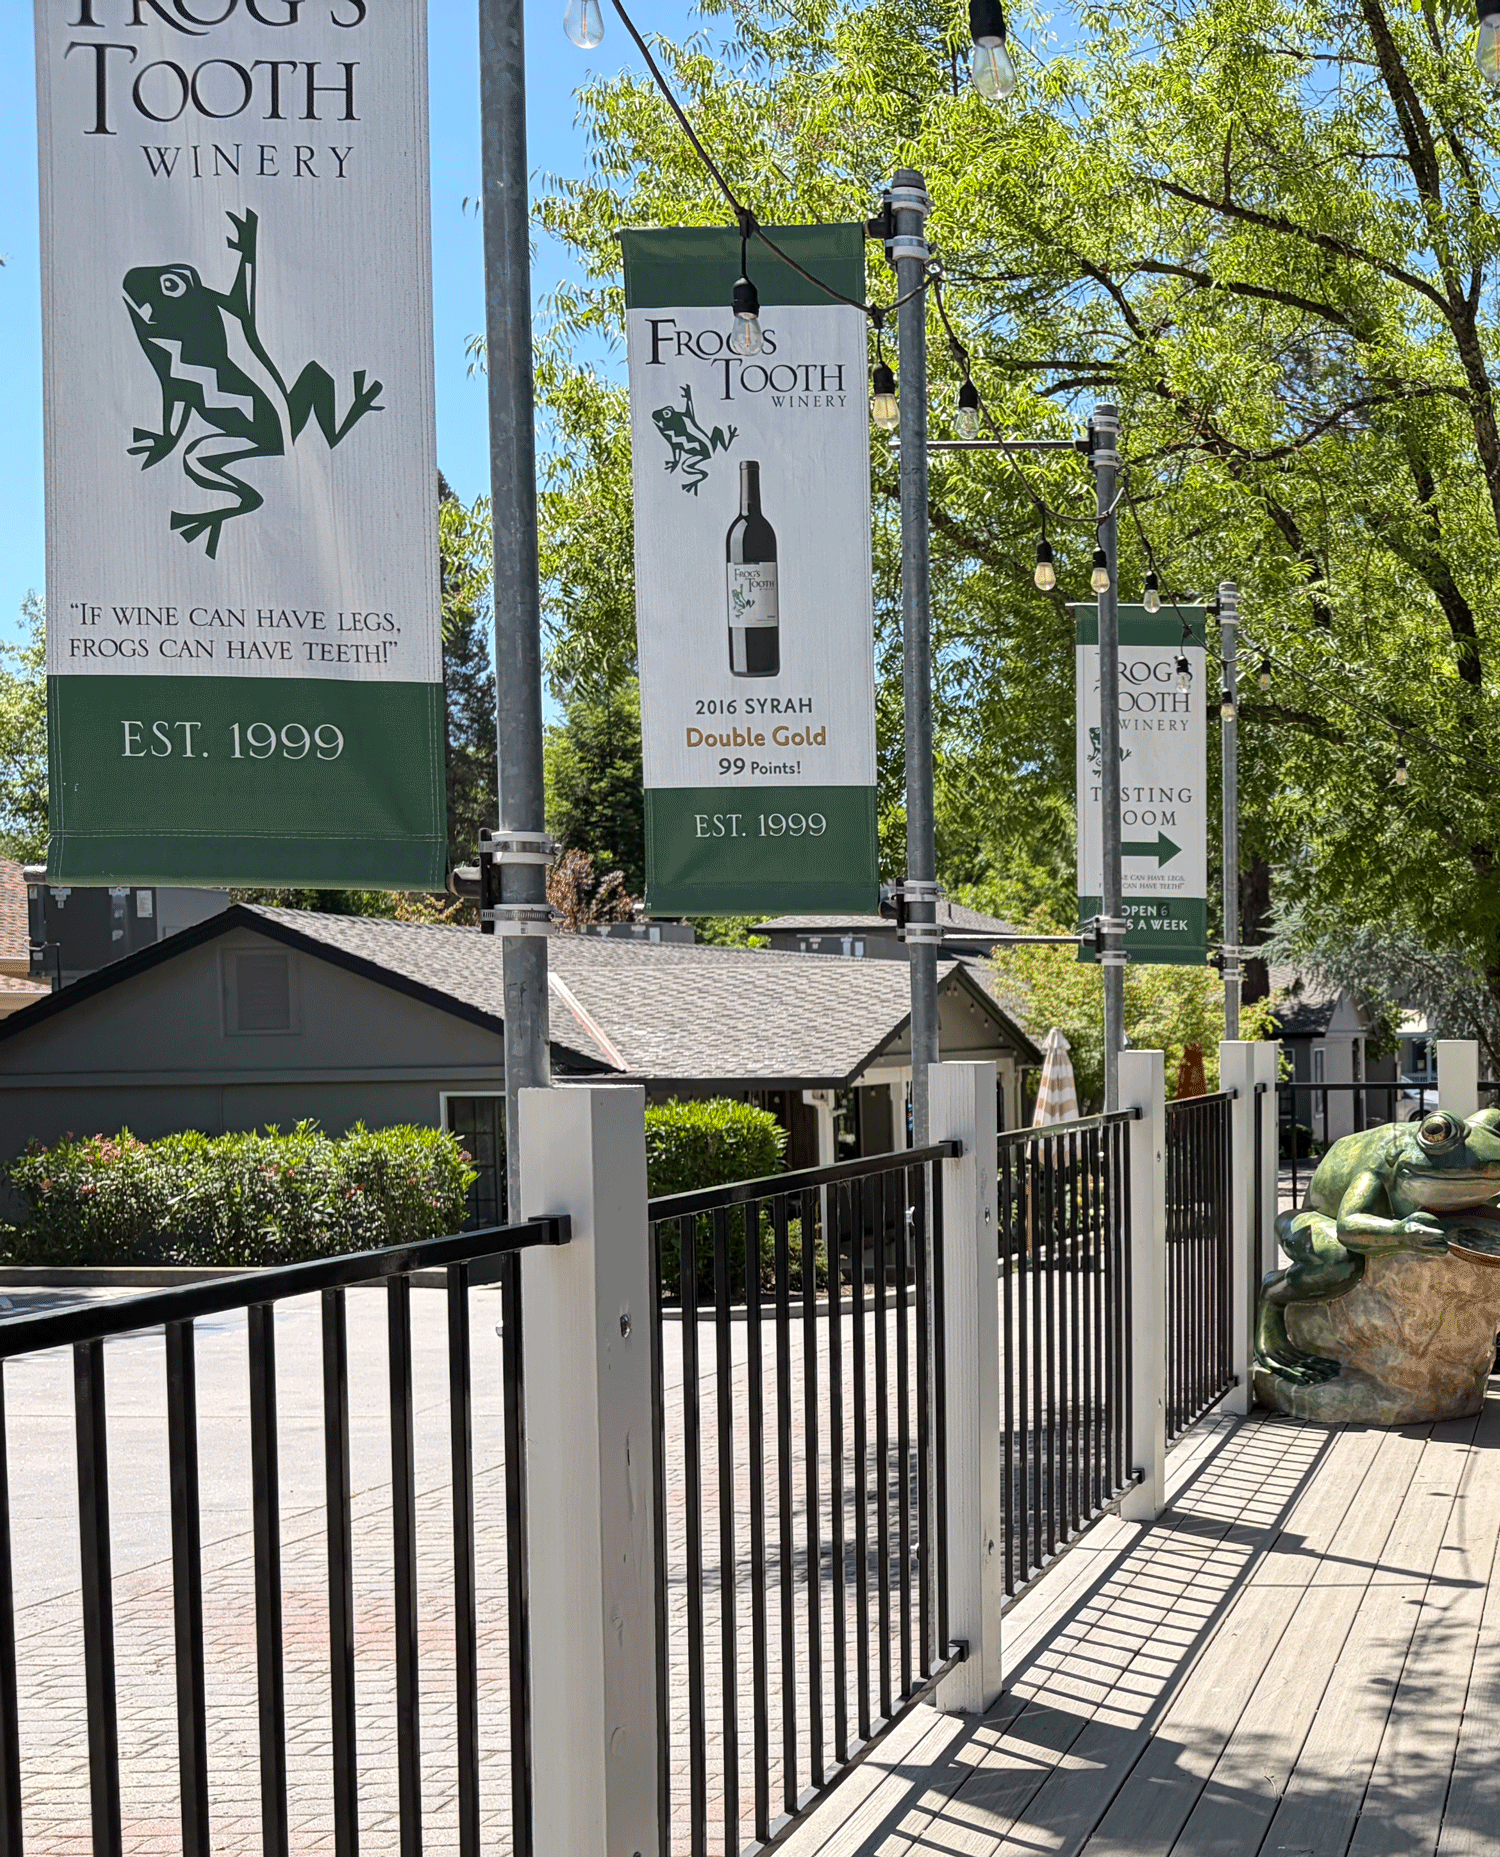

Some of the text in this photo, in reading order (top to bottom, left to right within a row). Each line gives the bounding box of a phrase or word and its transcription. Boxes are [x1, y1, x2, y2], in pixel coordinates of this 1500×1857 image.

[64, 41, 361, 135] TOOTH
[139, 143, 355, 179] WINERY
[645, 318, 777, 366] FROS
[710, 357, 847, 401] TOOTH
[771, 394, 847, 408] WINERY
[745, 577, 775, 593] TOOTH
[111, 606, 179, 626] WINE
[189, 607, 246, 627] CAN
[256, 608, 327, 630] HAVE
[337, 611, 401, 634] LEGS,
[68, 638, 149, 658] FROGS
[159, 638, 215, 659] CAN
[226, 640, 293, 660] HAVE
[695, 697, 813, 715] 2016 SYRAH
[1093, 685, 1192, 713] OOTH
[1118, 718, 1189, 731] WINERY
[120, 719, 346, 761] EST. 1999
[686, 725, 827, 748] Double Gold
[718, 757, 802, 776] 99 Points!
[1090, 786, 1192, 804] TSTING
[694, 812, 827, 838] EST. 1999
[1122, 809, 1177, 826] OOM
[1121, 904, 1169, 917] OPEN 6
[1137, 919, 1147, 930] A
[1150, 919, 1188, 931] WEEK
